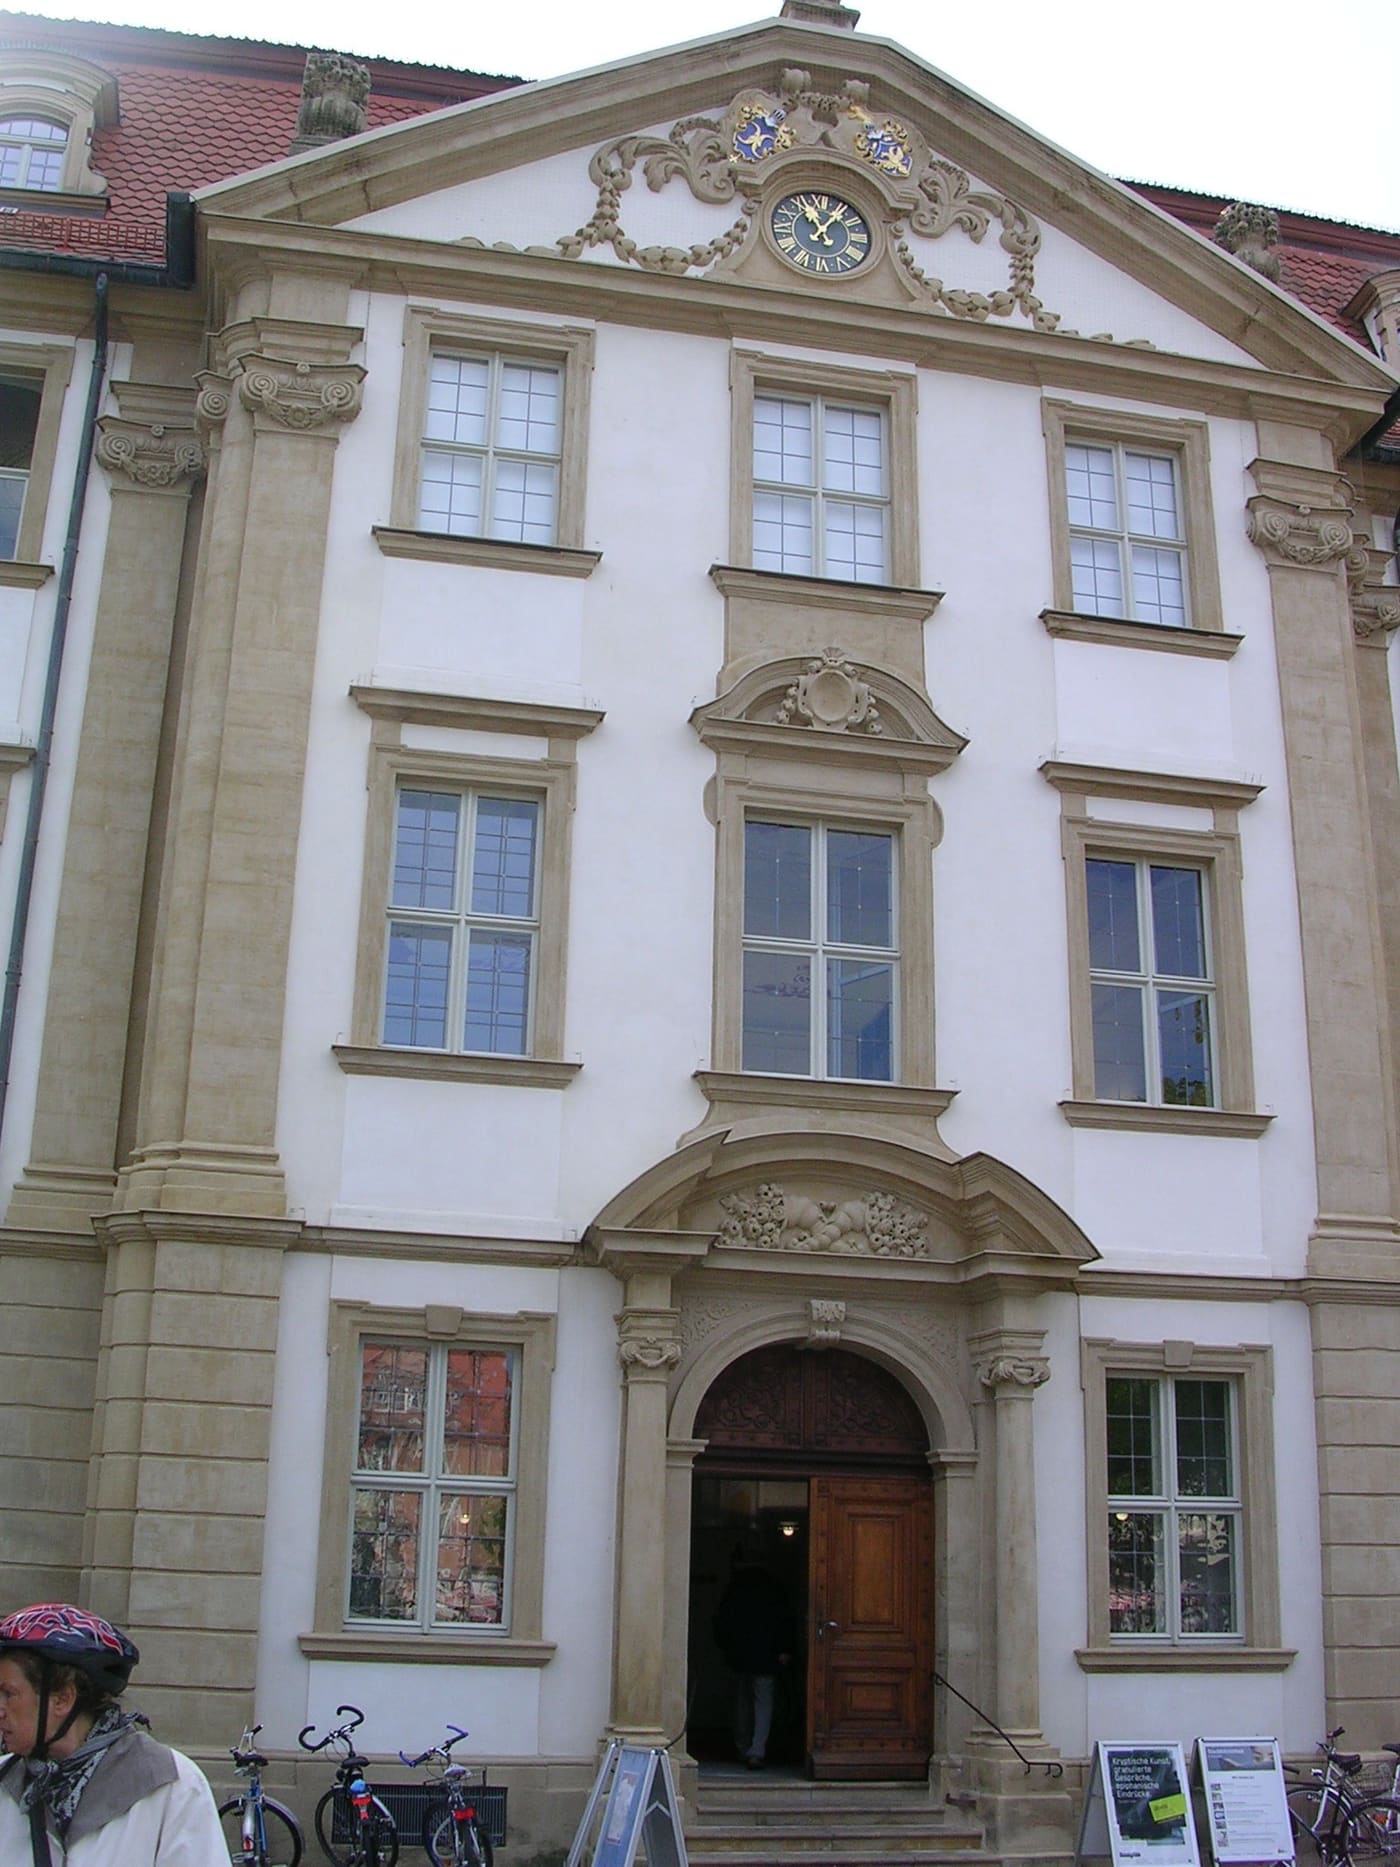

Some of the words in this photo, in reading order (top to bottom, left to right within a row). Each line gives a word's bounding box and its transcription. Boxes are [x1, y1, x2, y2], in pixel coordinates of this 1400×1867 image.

[778, 205, 796, 219] X
[836, 256, 851, 271] V
[1112, 1757, 1149, 1766] Kryptische
